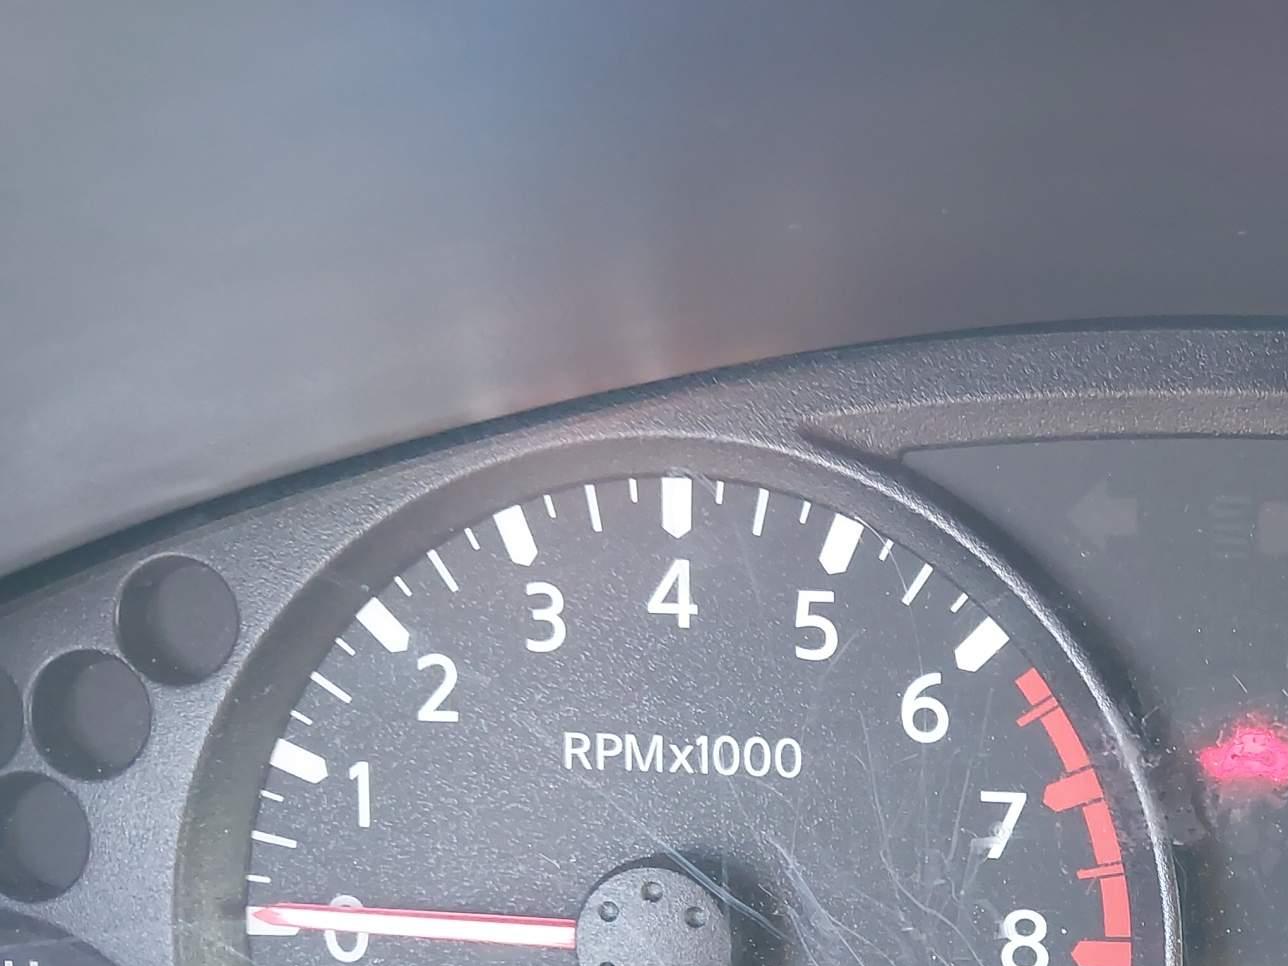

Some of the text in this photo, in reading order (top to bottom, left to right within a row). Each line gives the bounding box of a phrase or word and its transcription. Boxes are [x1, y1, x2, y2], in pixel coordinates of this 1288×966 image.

[525, 581, 566, 653] 3
[645, 558, 698, 629] 4
[795, 589, 839, 660] 5
[416, 653, 459, 722] 2
[901, 672, 950, 743] 6
[564, 731, 802, 778] RPMx1000
[348, 761, 371, 828] 1
[980, 790, 1027, 859] 7
